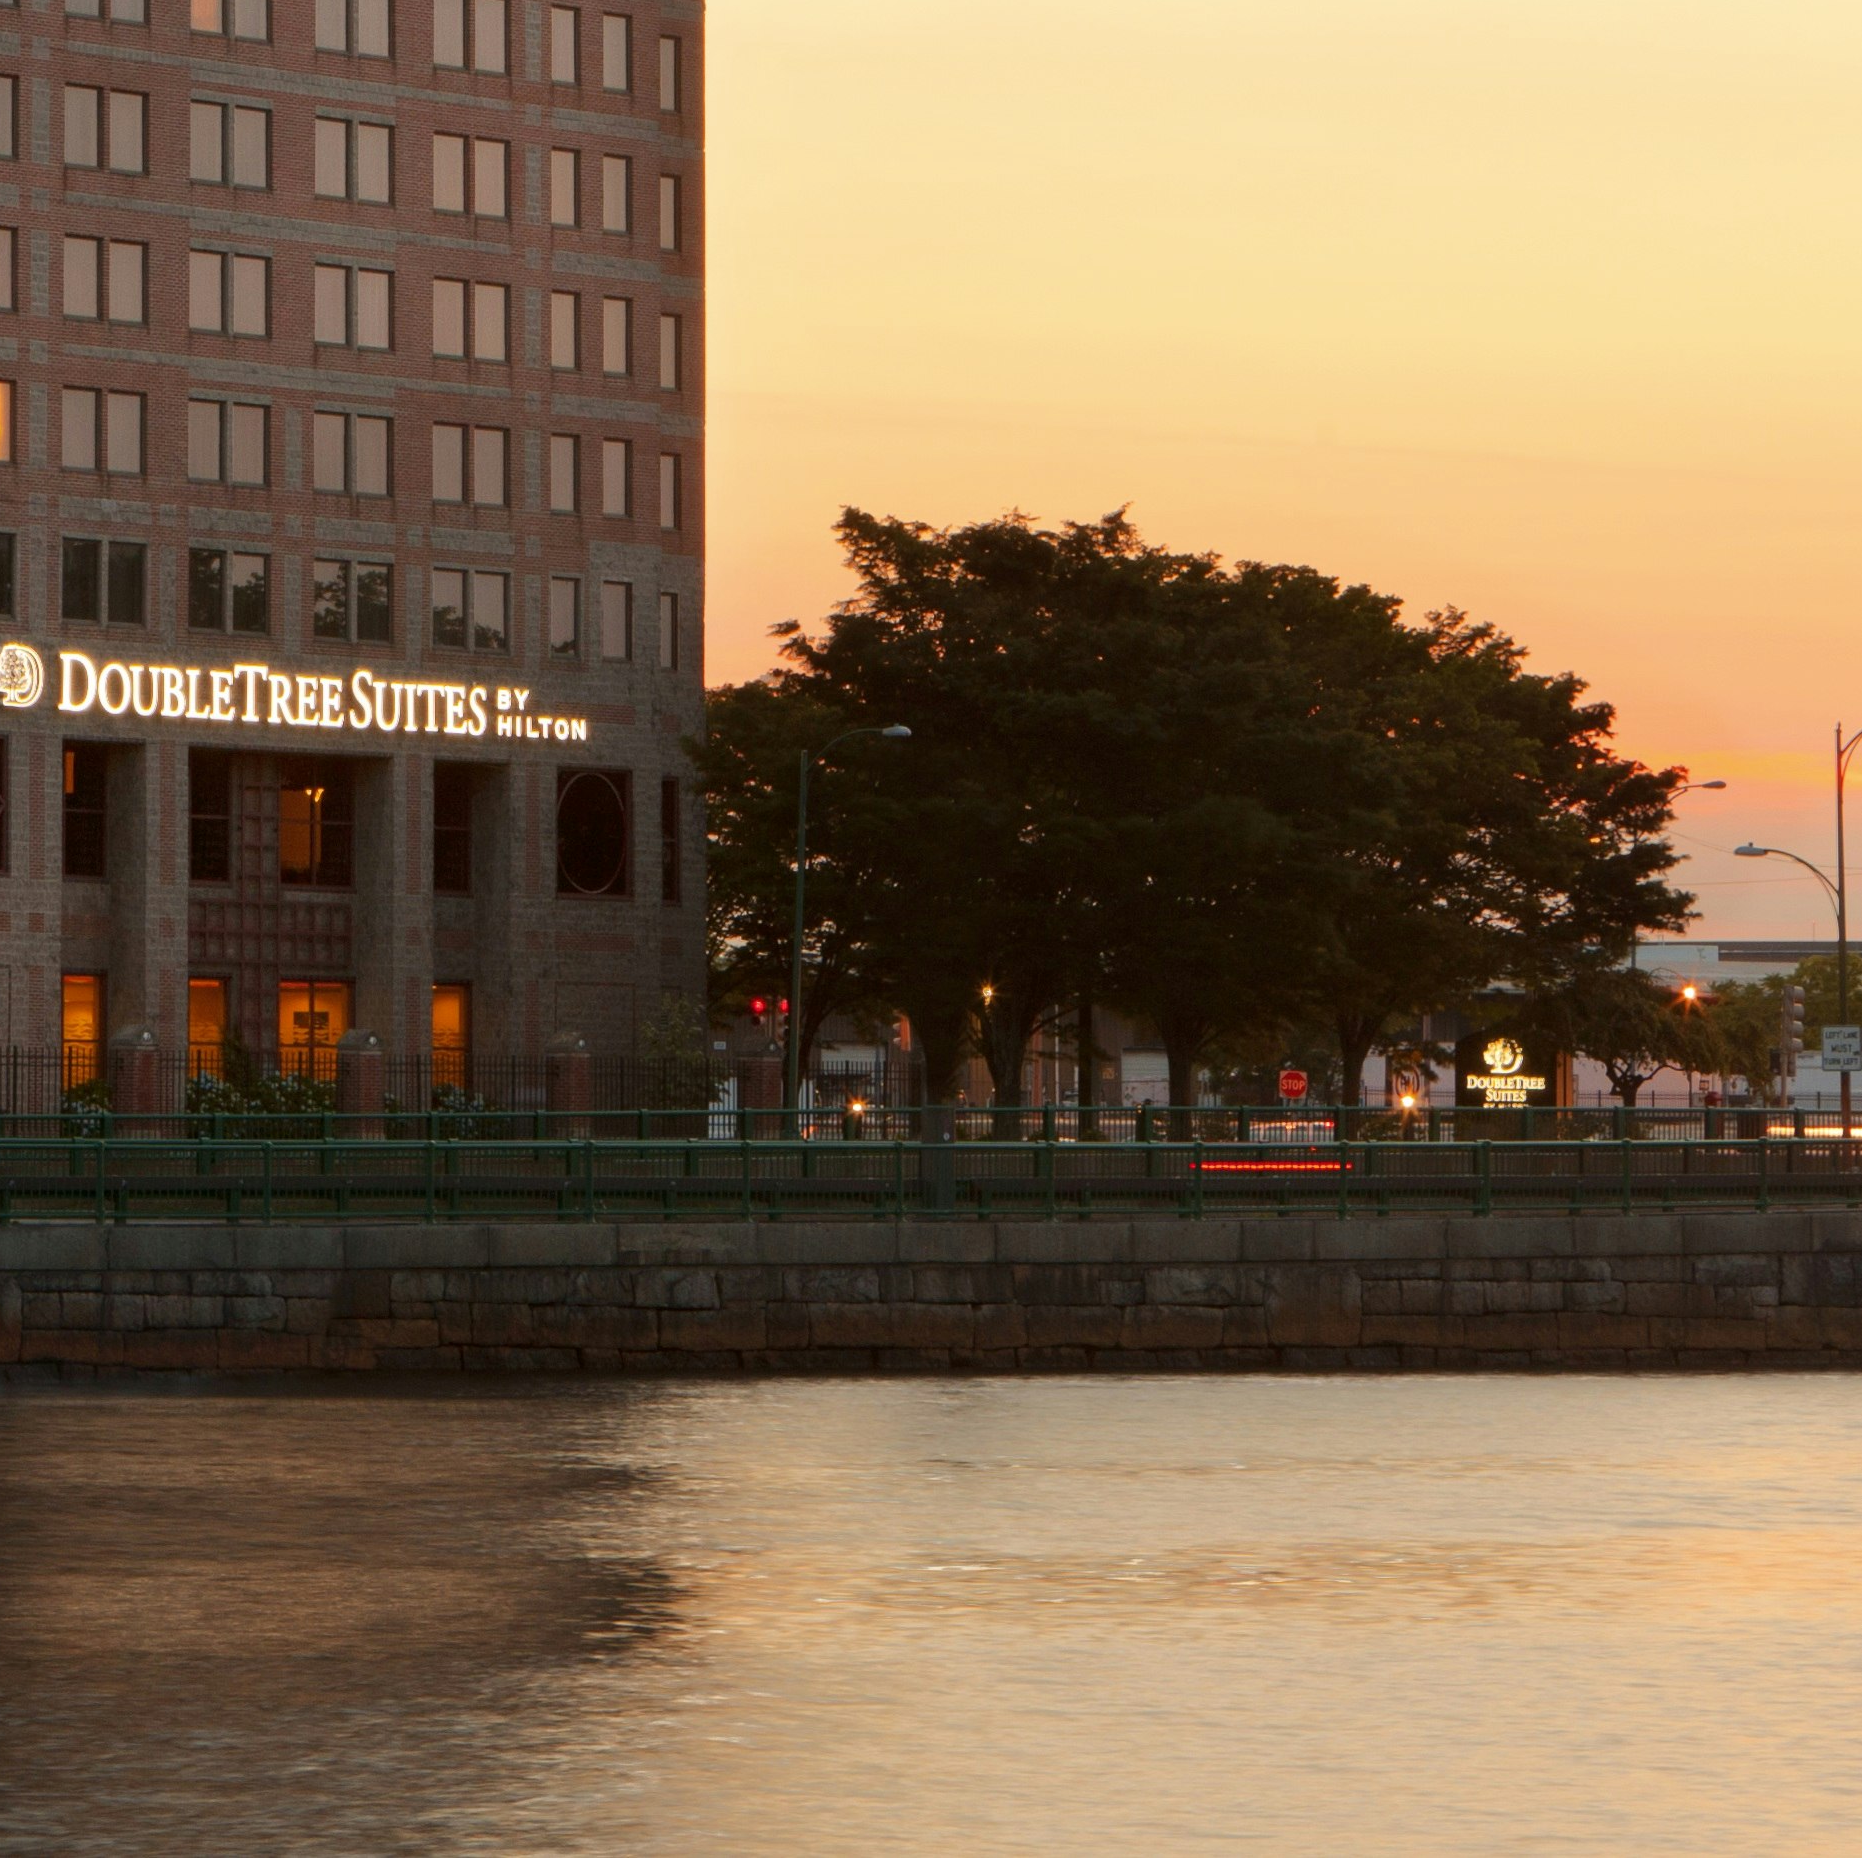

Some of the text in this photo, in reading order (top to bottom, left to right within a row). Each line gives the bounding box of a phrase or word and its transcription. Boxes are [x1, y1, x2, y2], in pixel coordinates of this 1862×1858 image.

[496, 688, 531, 712] BY
[496, 714, 588, 742] HILTON
[1281, 1079, 1305, 1091] STOP
